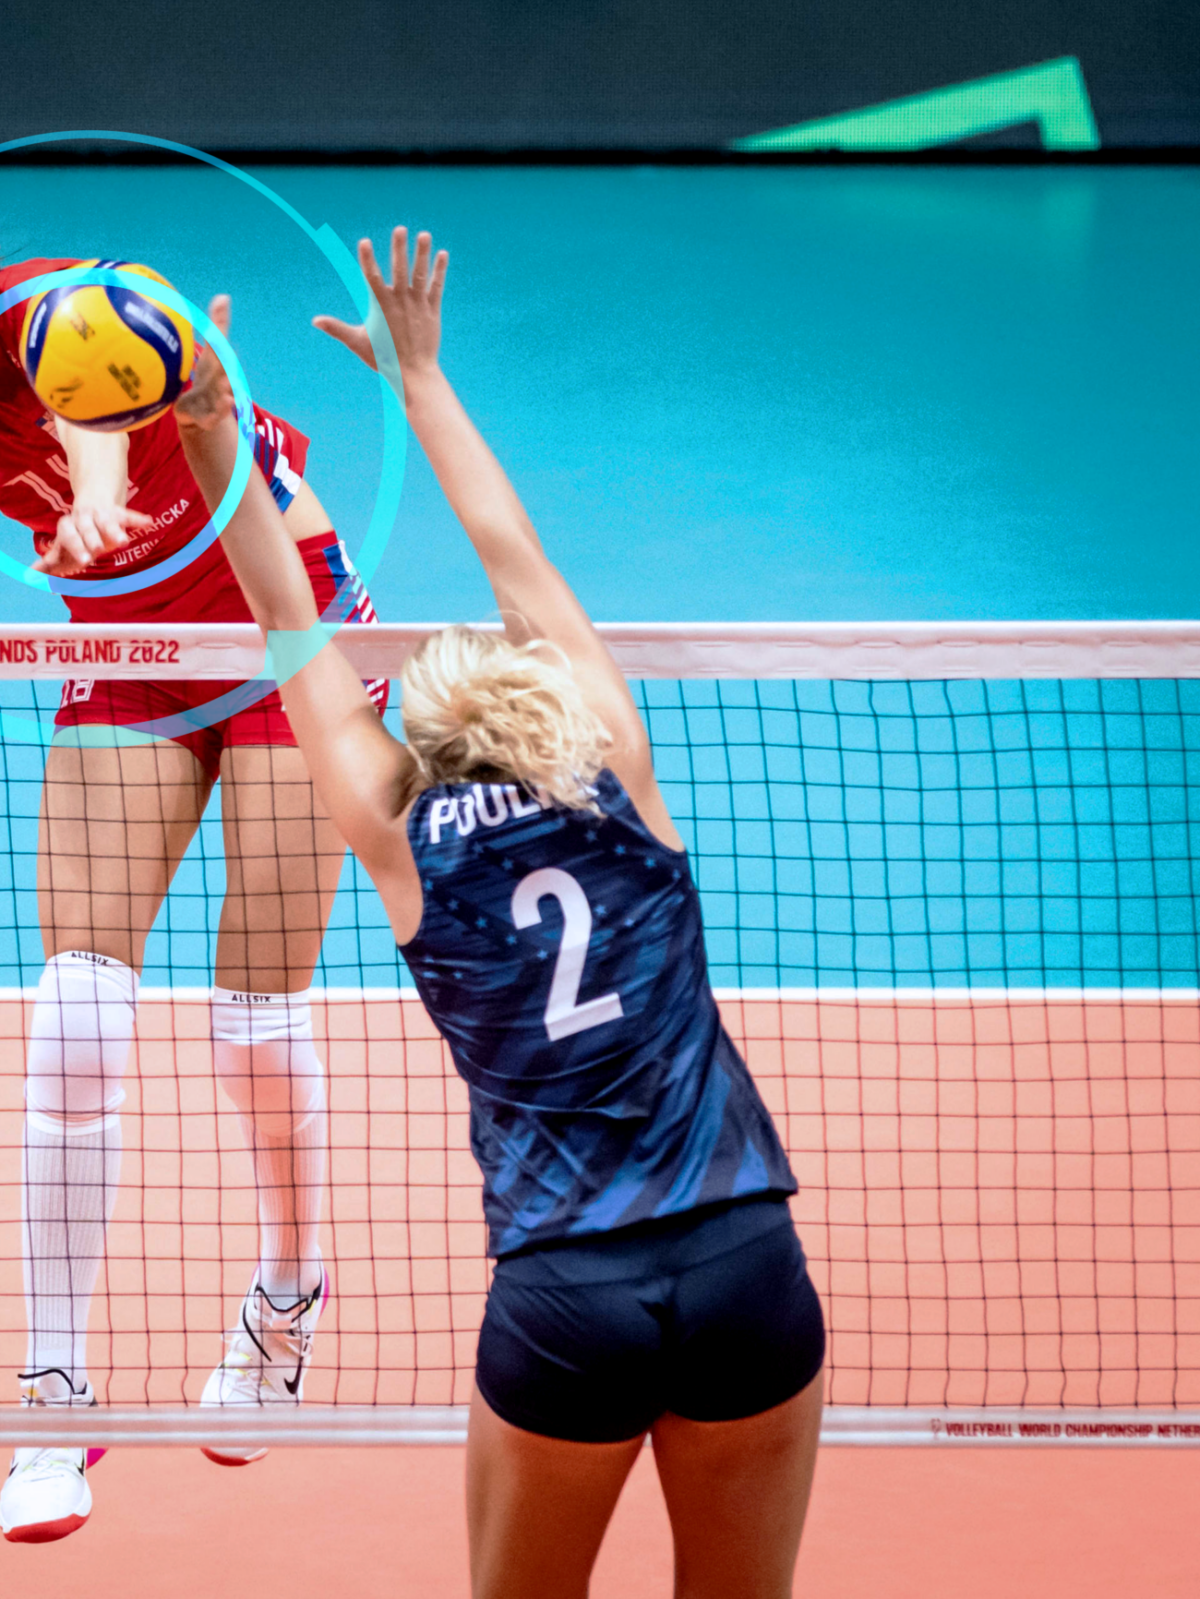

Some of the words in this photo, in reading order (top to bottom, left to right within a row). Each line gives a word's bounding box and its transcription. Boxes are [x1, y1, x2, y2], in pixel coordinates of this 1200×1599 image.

[46, 639, 121, 664] POLAND
[129, 639, 180, 664] 2022
[71, 951, 109, 966] ALLSIX
[511, 867, 624, 1042] 2
[231, 993, 271, 1003] ALLSIX
[946, 1423, 1013, 1437] VOLLEYBALL
[1018, 1423, 1061, 1437] WORLD
[1065, 1423, 1153, 1437] CHAMPIONSHIP
